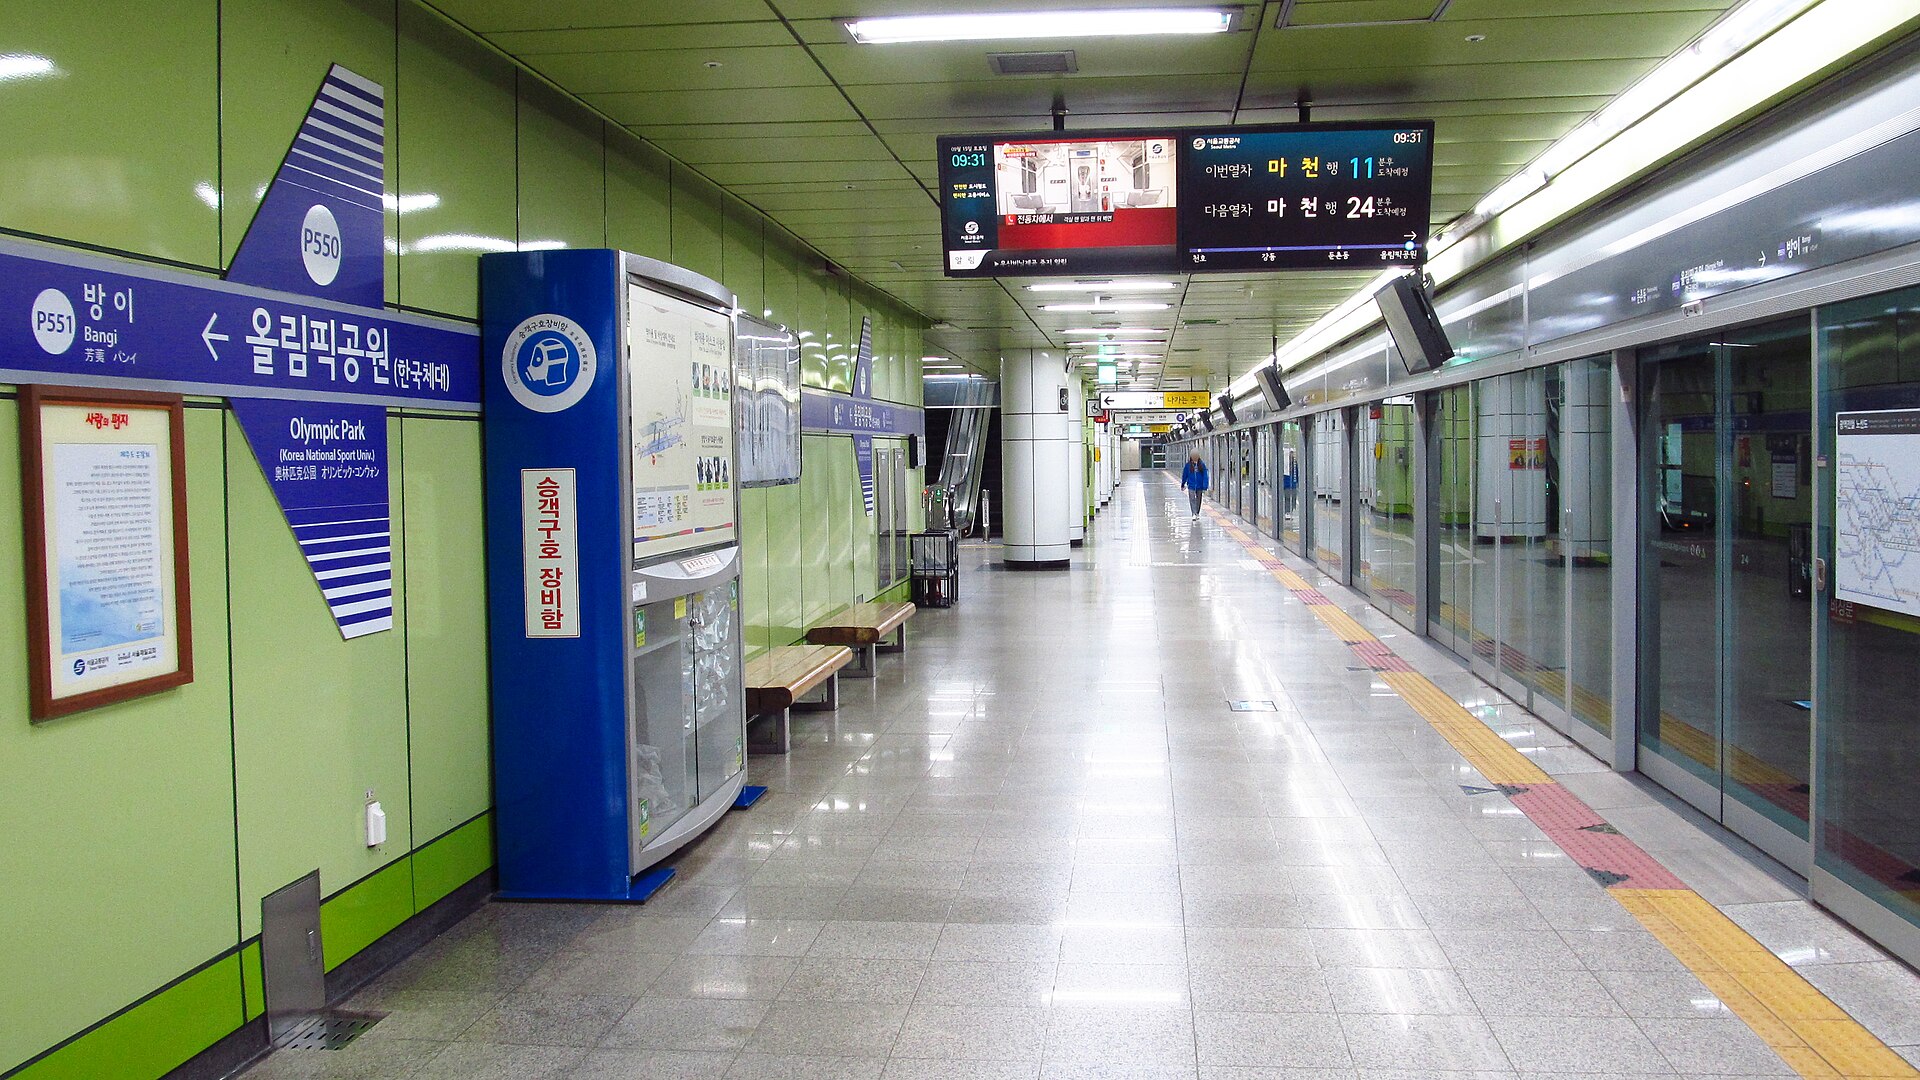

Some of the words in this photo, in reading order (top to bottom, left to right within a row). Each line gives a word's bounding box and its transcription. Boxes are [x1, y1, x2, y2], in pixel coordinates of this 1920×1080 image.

[1393, 132, 1422, 144] 09:31
[952, 154, 985, 167] 09:31
[1205, 164, 1252, 178] 이번열차
[1326, 162, 1338, 176] 행
[1350, 156, 1373, 178] 11
[1377, 167, 1408, 176] 도착예정
[1204, 203, 1253, 218] 다음열차
[1325, 201, 1337, 216] 행
[1346, 196, 1376, 218] 24
[1376, 207, 1406, 216] 도착예정
[1017, 214, 1054, 224] 전동차에서
[303, 229, 340, 260] P550
[1261, 253, 1276, 262] 강동
[1380, 250, 1418, 260] 올림픽공원
[37, 310, 74, 334] P551
[84, 326, 118, 348] Bangi
[113, 350, 137, 364] パンイ
[246, 307, 390, 386] 올림픽공원
[393, 358, 451, 392] (한국체대)
[1167, 396, 1188, 405] 나가는
[1190, 396, 1198, 404] 곳
[86, 412, 110, 430] 사랑의
[110, 413, 129, 430] 편지
[290, 417, 340, 442] Olympic
[341, 419, 366, 441] Park
[280, 448, 305, 464] (Korea
[306, 448, 337, 462] National
[338, 448, 358, 464] Sport
[358, 448, 376, 464] Univ.)
[536, 476, 562, 559] 승객구호
[539, 566, 564, 630] 장비함
